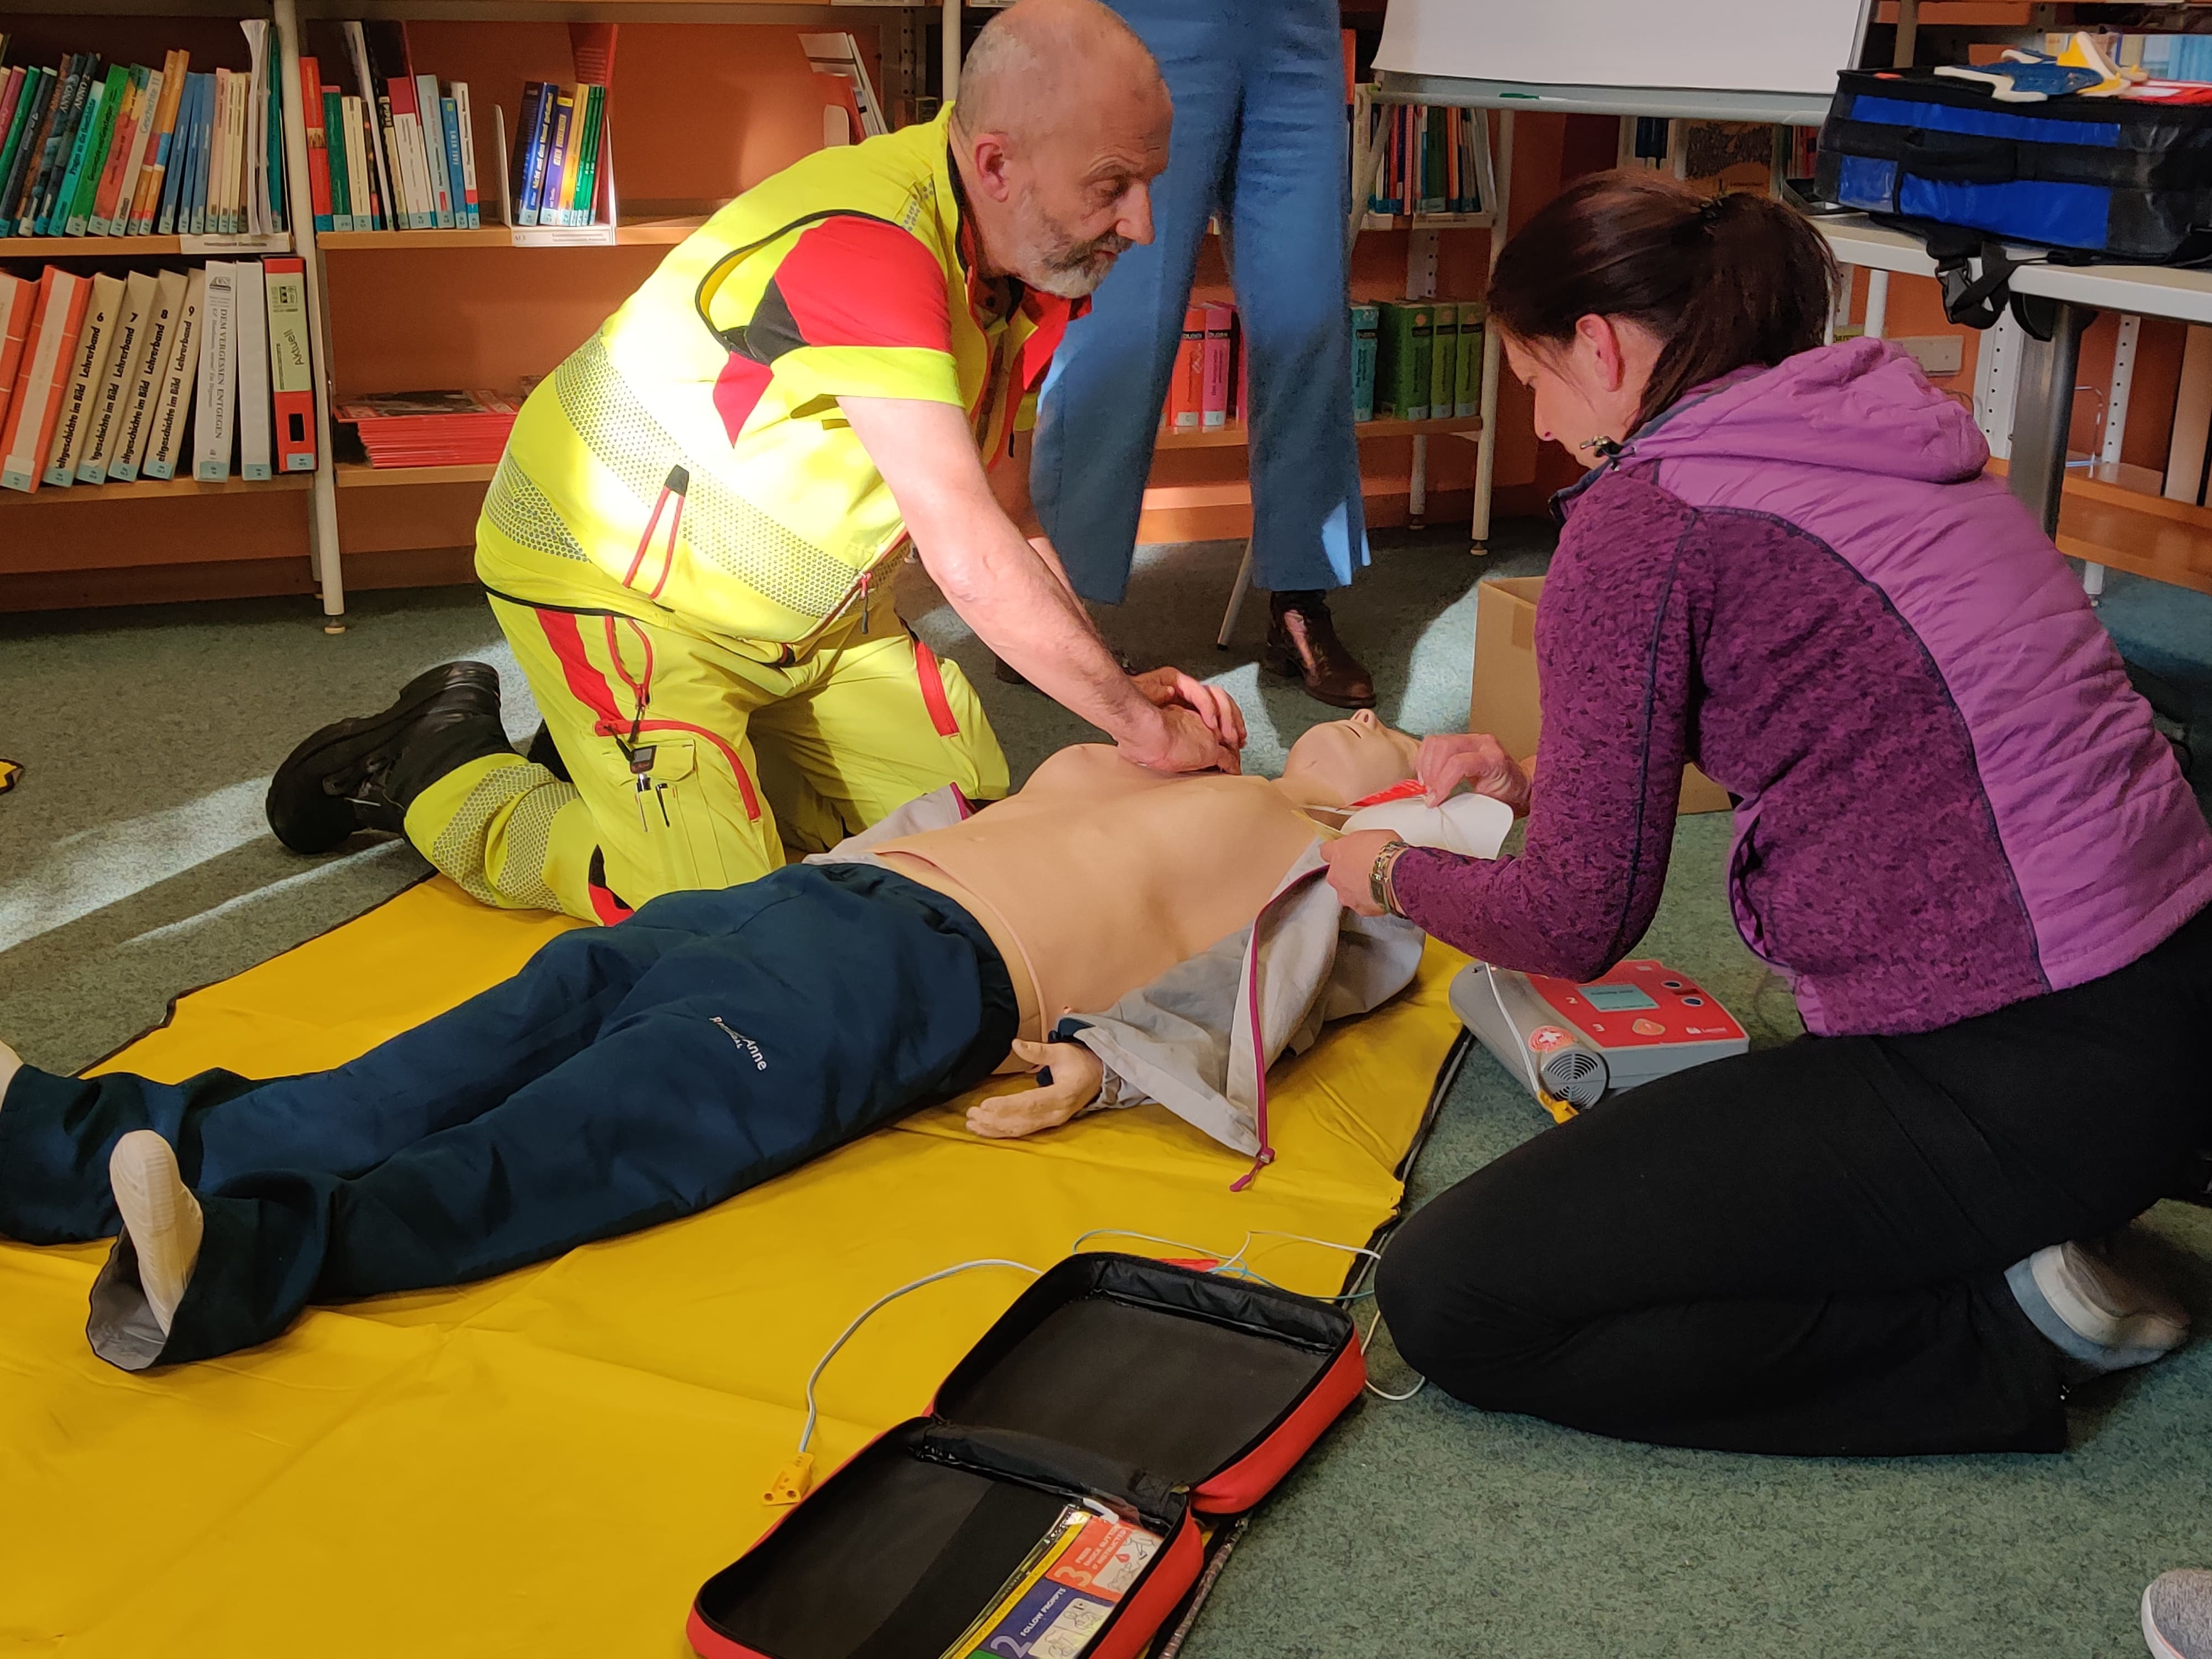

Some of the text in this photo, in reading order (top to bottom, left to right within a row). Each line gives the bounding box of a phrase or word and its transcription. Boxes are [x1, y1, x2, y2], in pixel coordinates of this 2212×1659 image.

[60, 85, 74, 113] ANNO
[74, 82, 87, 110] ANNO
[139, 88, 158, 134] Geschichte
[129, 312, 138, 322] 7
[113, 326, 135, 378] Lehrerband
[283, 328, 305, 366] Aktuell
[55, 312, 105, 469] eltgeschichte im Bild Lehrerband 6
[121, 309, 168, 465] eltgeschichte im Bild Lehrerband 8
[156, 306, 195, 462] eltgeschichte im Bild Lehrerband 9
[215, 309, 228, 439] DEM VERGESSEN ENTGEGEN
[103, 401, 114, 414] im
[107, 383, 119, 402] Bild
[742, 1039, 768, 1071] Anne
[1053, 1566, 1093, 1588] 3
[1020, 1587, 1067, 1637] FOLLOW PROMPTS
[990, 1635, 1034, 1659] 2
